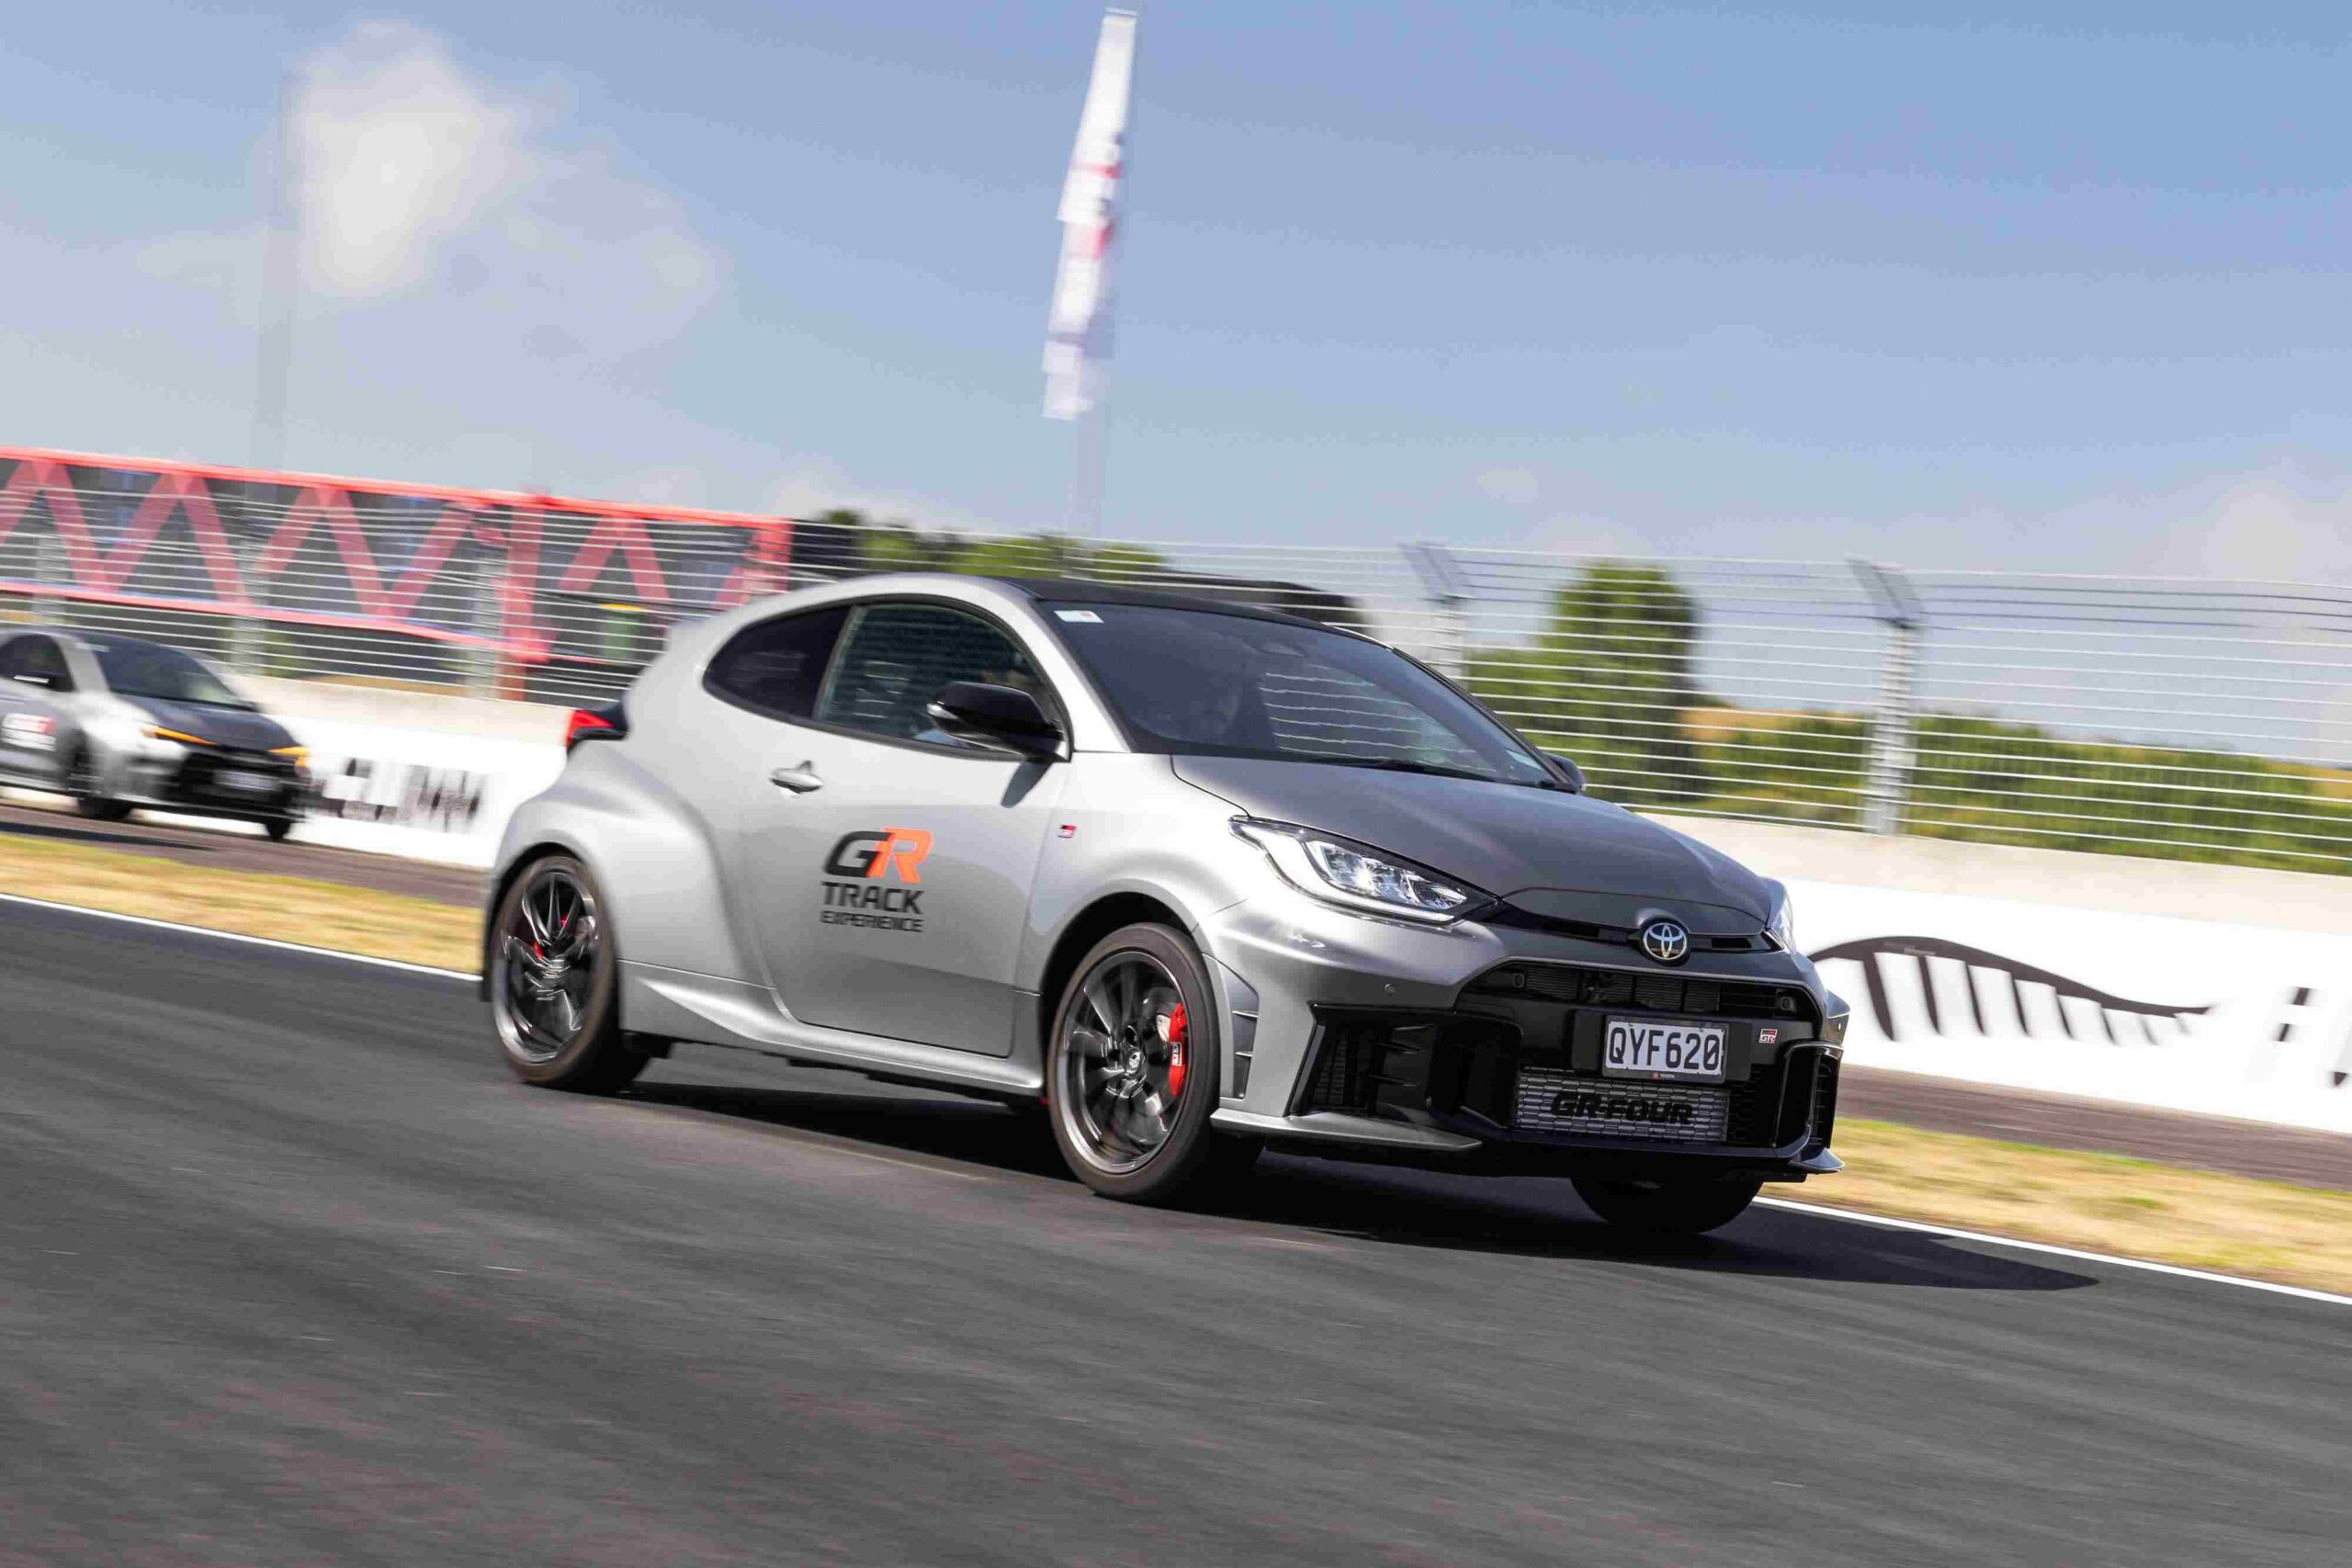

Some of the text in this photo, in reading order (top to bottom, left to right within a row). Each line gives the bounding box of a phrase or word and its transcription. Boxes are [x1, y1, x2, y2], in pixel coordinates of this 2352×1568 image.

[823, 828, 933, 884] GR
[821, 881, 925, 915] TRACK
[820, 910, 924, 932] EXPERIENCE
[1609, 1026, 1721, 1071] QYF620
